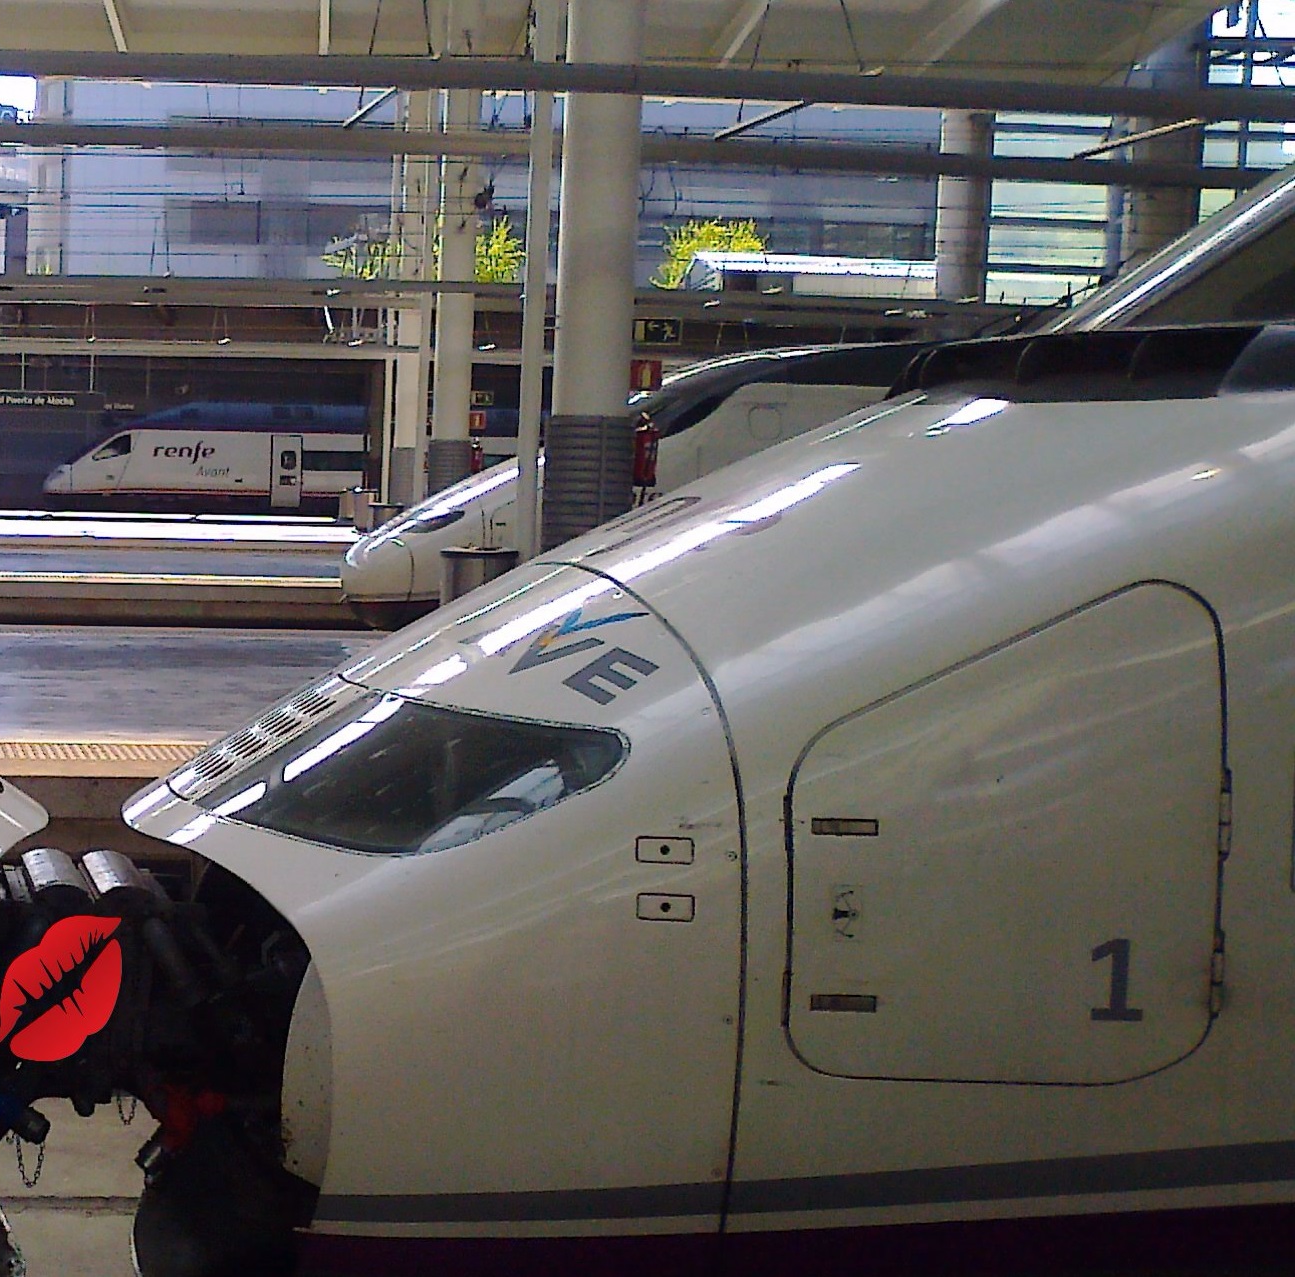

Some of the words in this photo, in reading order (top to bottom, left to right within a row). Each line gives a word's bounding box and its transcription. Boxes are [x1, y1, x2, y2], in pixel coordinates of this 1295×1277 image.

[153, 440, 216, 465] renfe
[196, 466, 230, 478] Avant
[1090, 938, 1144, 1022] 1
